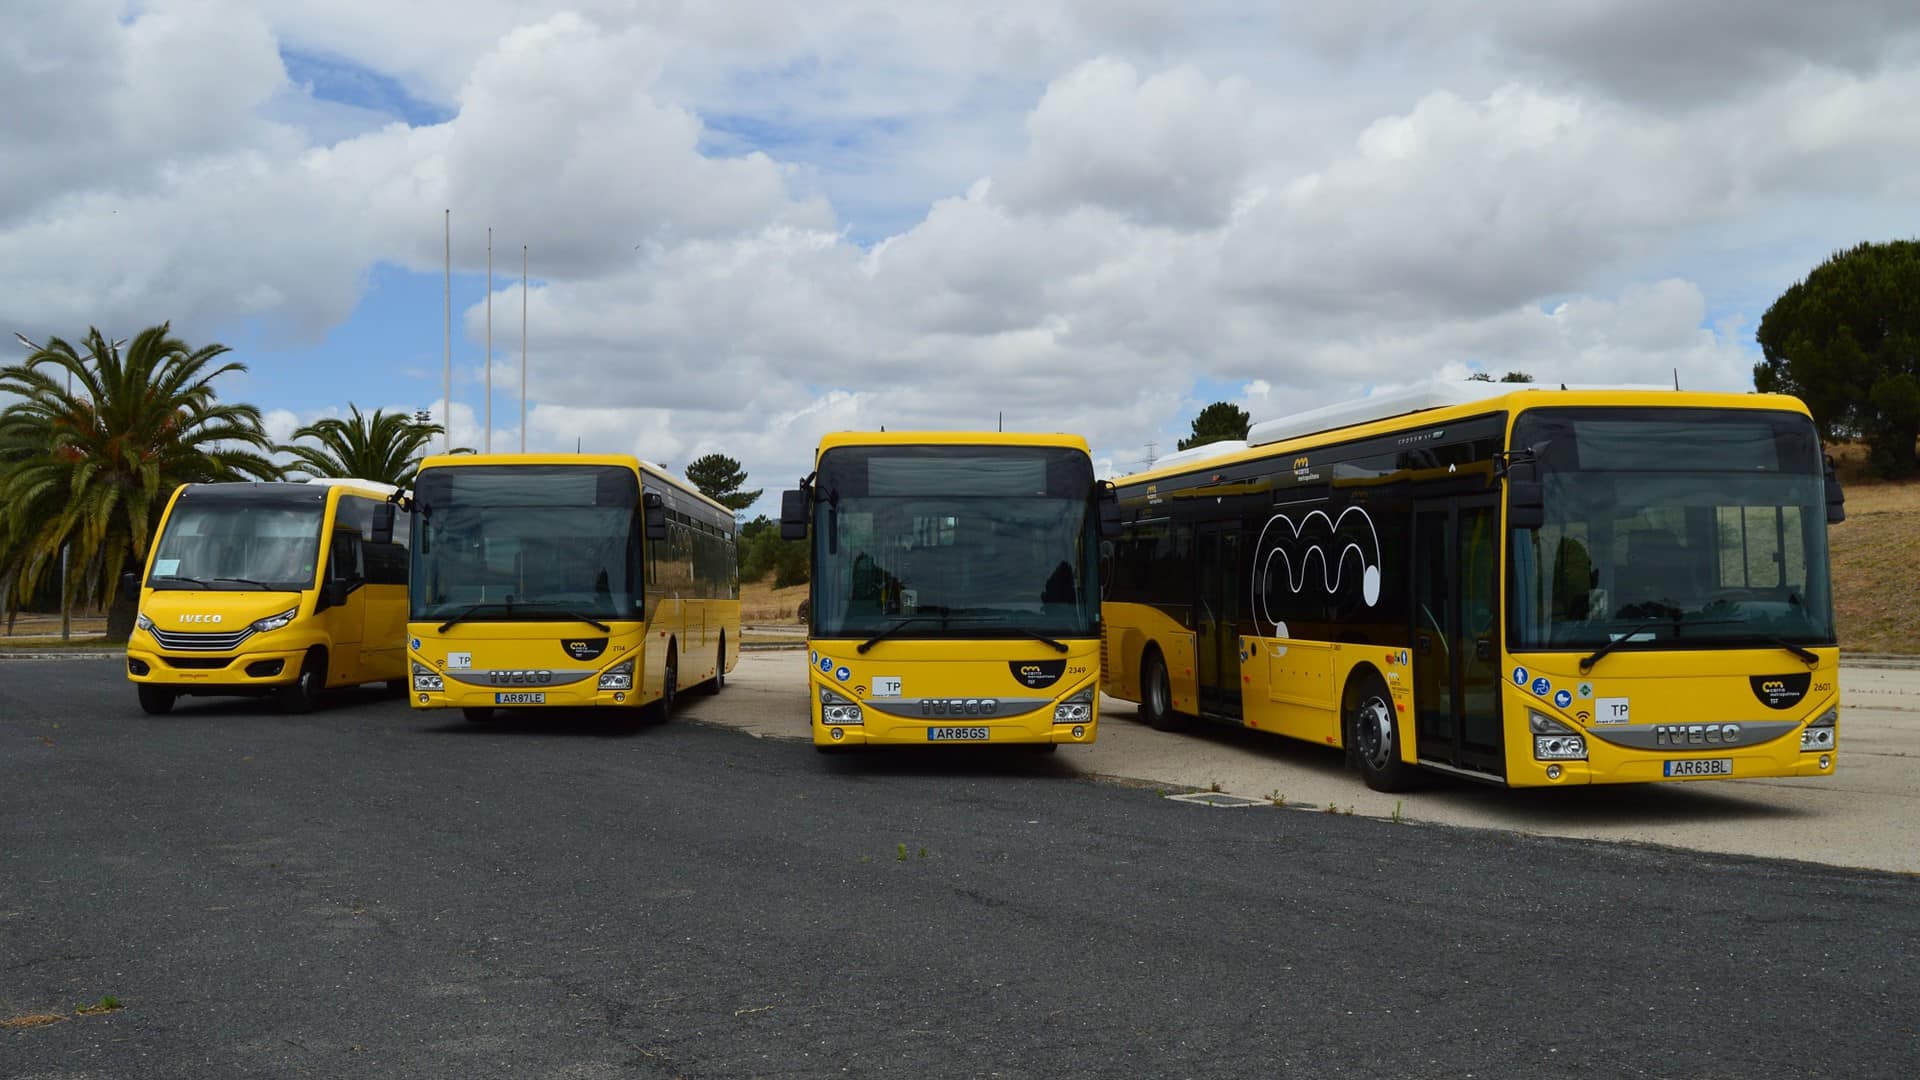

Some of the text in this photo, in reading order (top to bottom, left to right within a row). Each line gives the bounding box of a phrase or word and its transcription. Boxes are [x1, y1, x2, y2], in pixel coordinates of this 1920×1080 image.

[179, 614, 222, 623] IVECO
[458, 656, 471, 665] TP
[1069, 666, 1087, 674] 2349
[489, 670, 551, 683] IVECO
[885, 681, 901, 692] TP
[1814, 683, 1831, 692] 2601
[503, 693, 542, 703] AR87LE
[922, 698, 997, 715] IVECO
[1610, 703, 1629, 717] TP
[936, 728, 986, 739] AR85GS
[1656, 723, 1741, 746] IVECO
[1674, 760, 1727, 775] AR63BL
